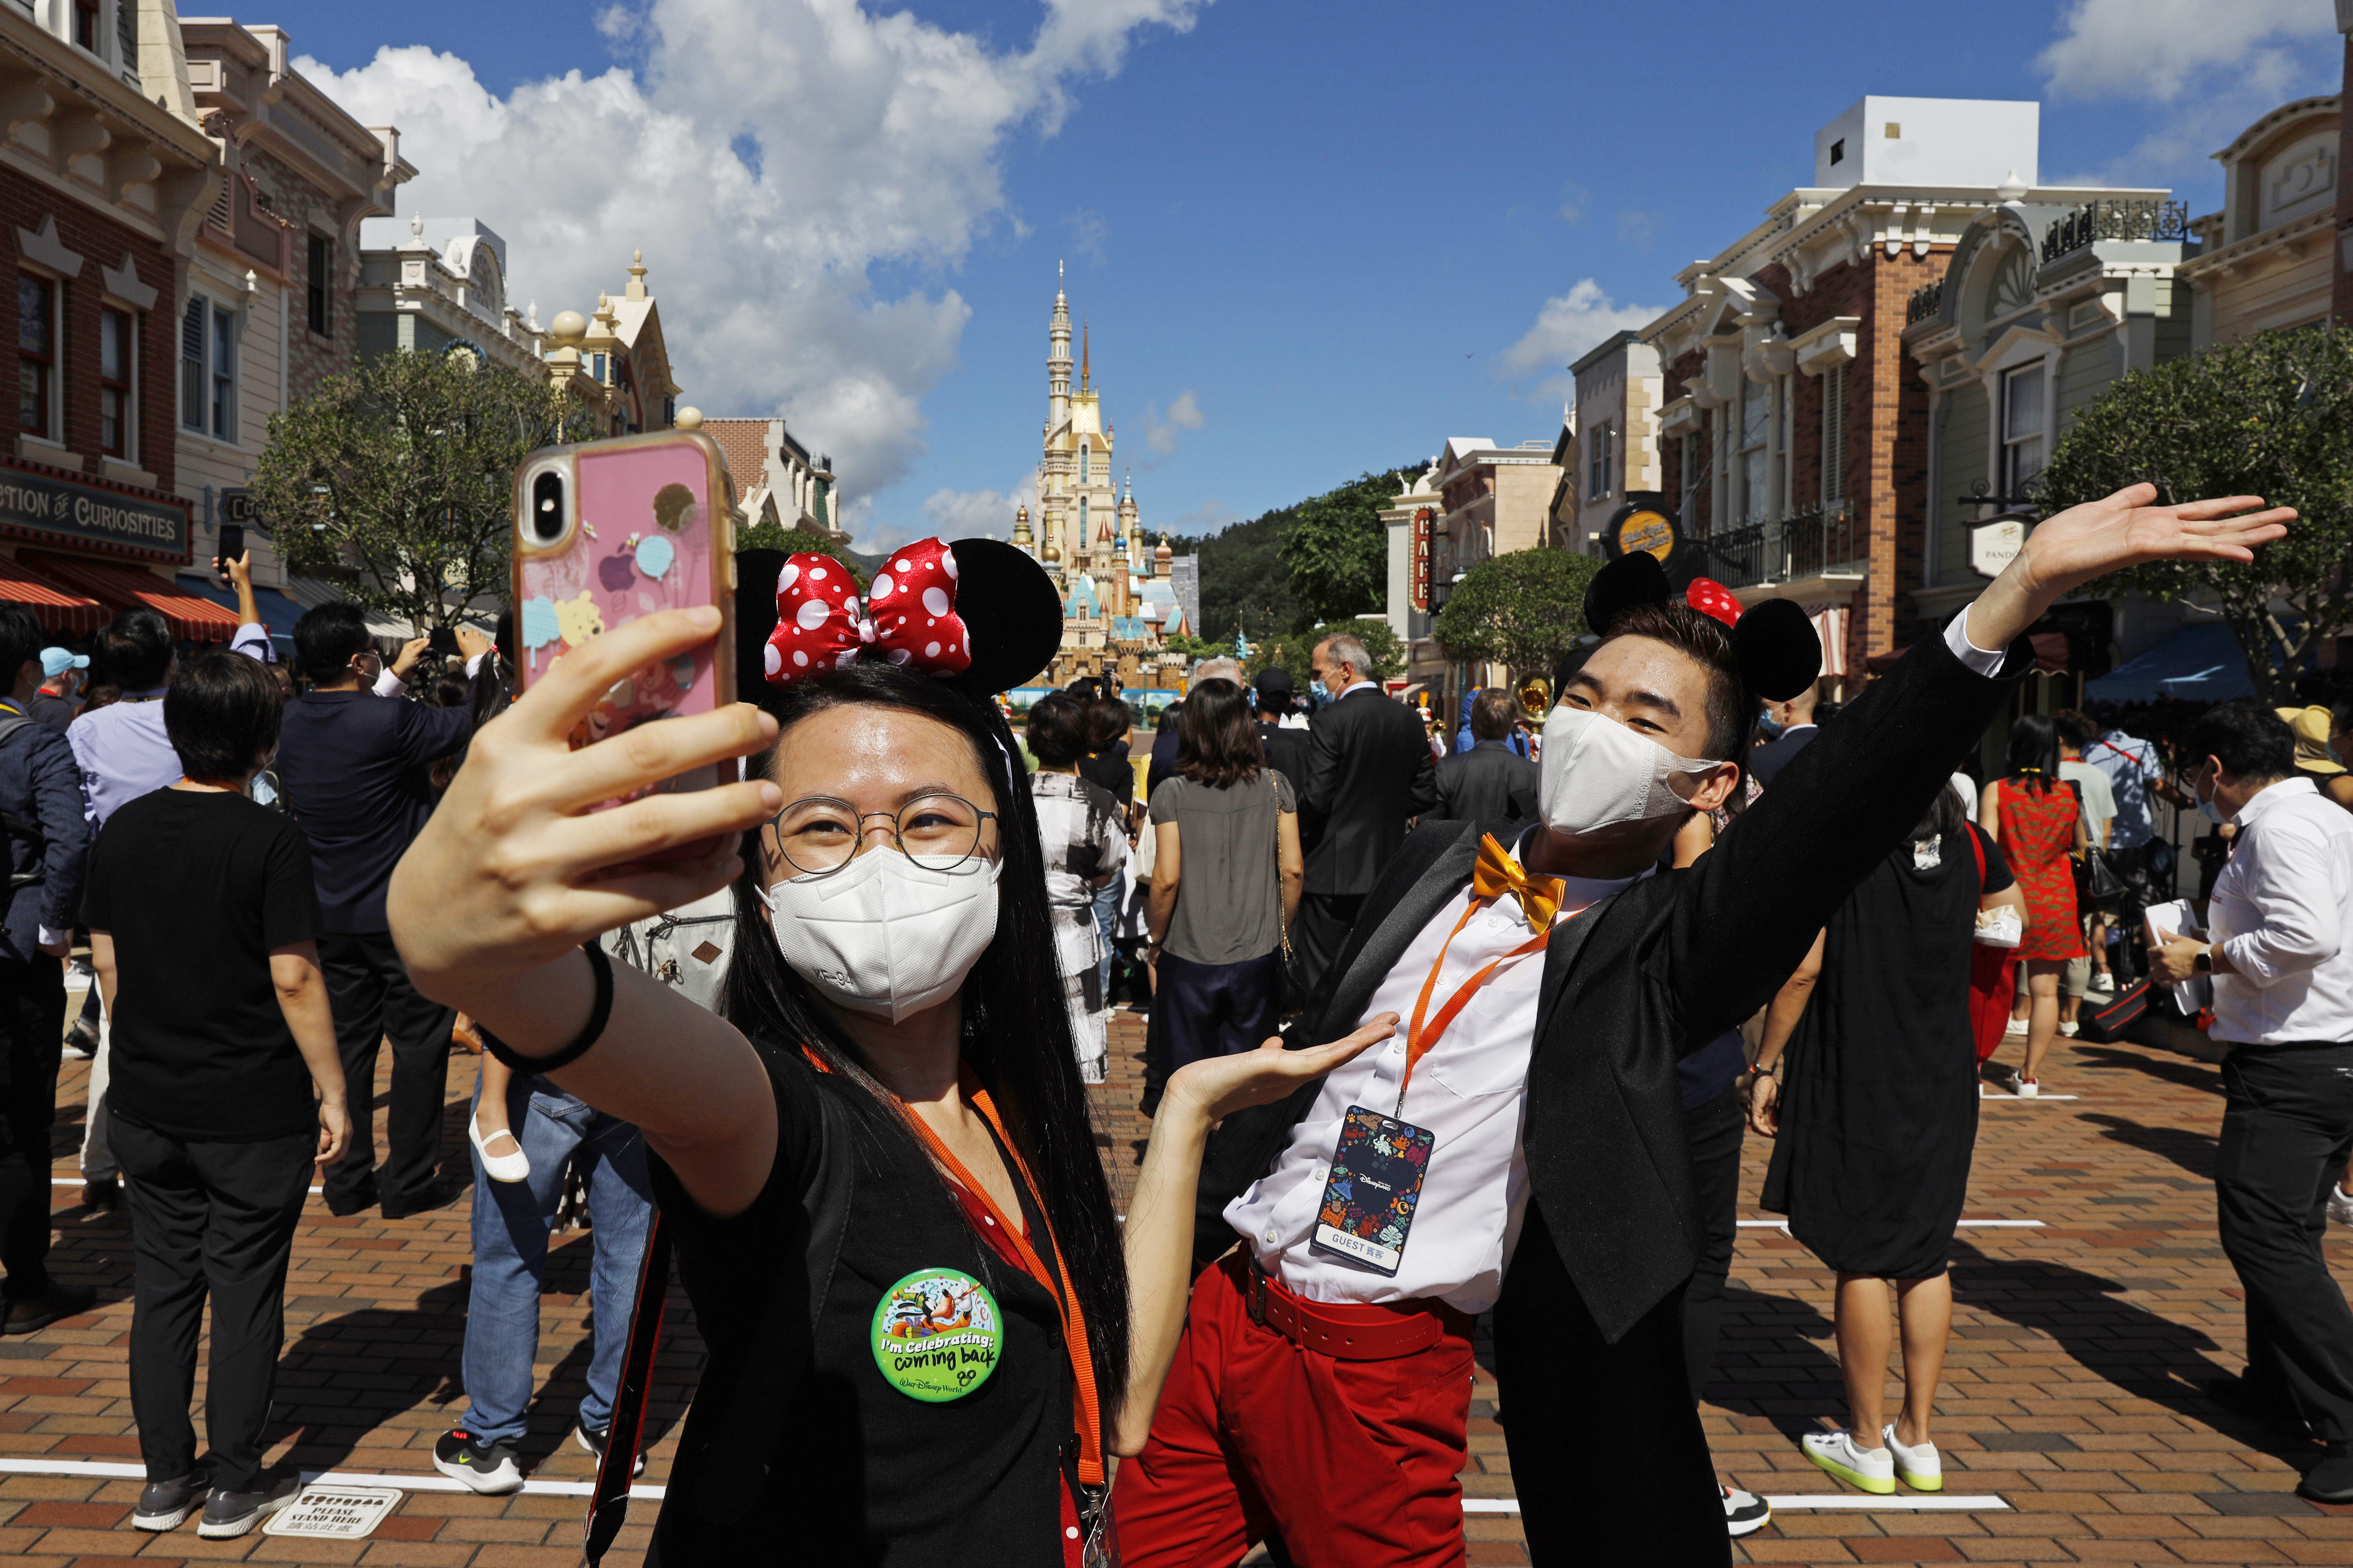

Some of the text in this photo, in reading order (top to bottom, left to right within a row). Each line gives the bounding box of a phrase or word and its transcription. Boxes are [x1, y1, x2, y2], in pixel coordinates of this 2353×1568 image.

[54, 495, 69, 517] OF
[75, 497, 175, 542] CURIOSITIES
[1419, 519, 1429, 599] CAFE
[1332, 1234, 1365, 1252] GUEST
[1366, 1246, 1384, 1260] 賓客
[881, 1332, 994, 1353] I'm Celebrating:
[894, 1347, 996, 1371] coming back
[312, 1507, 356, 1516] PLEASE
[331, 1516, 364, 1524] HERE
